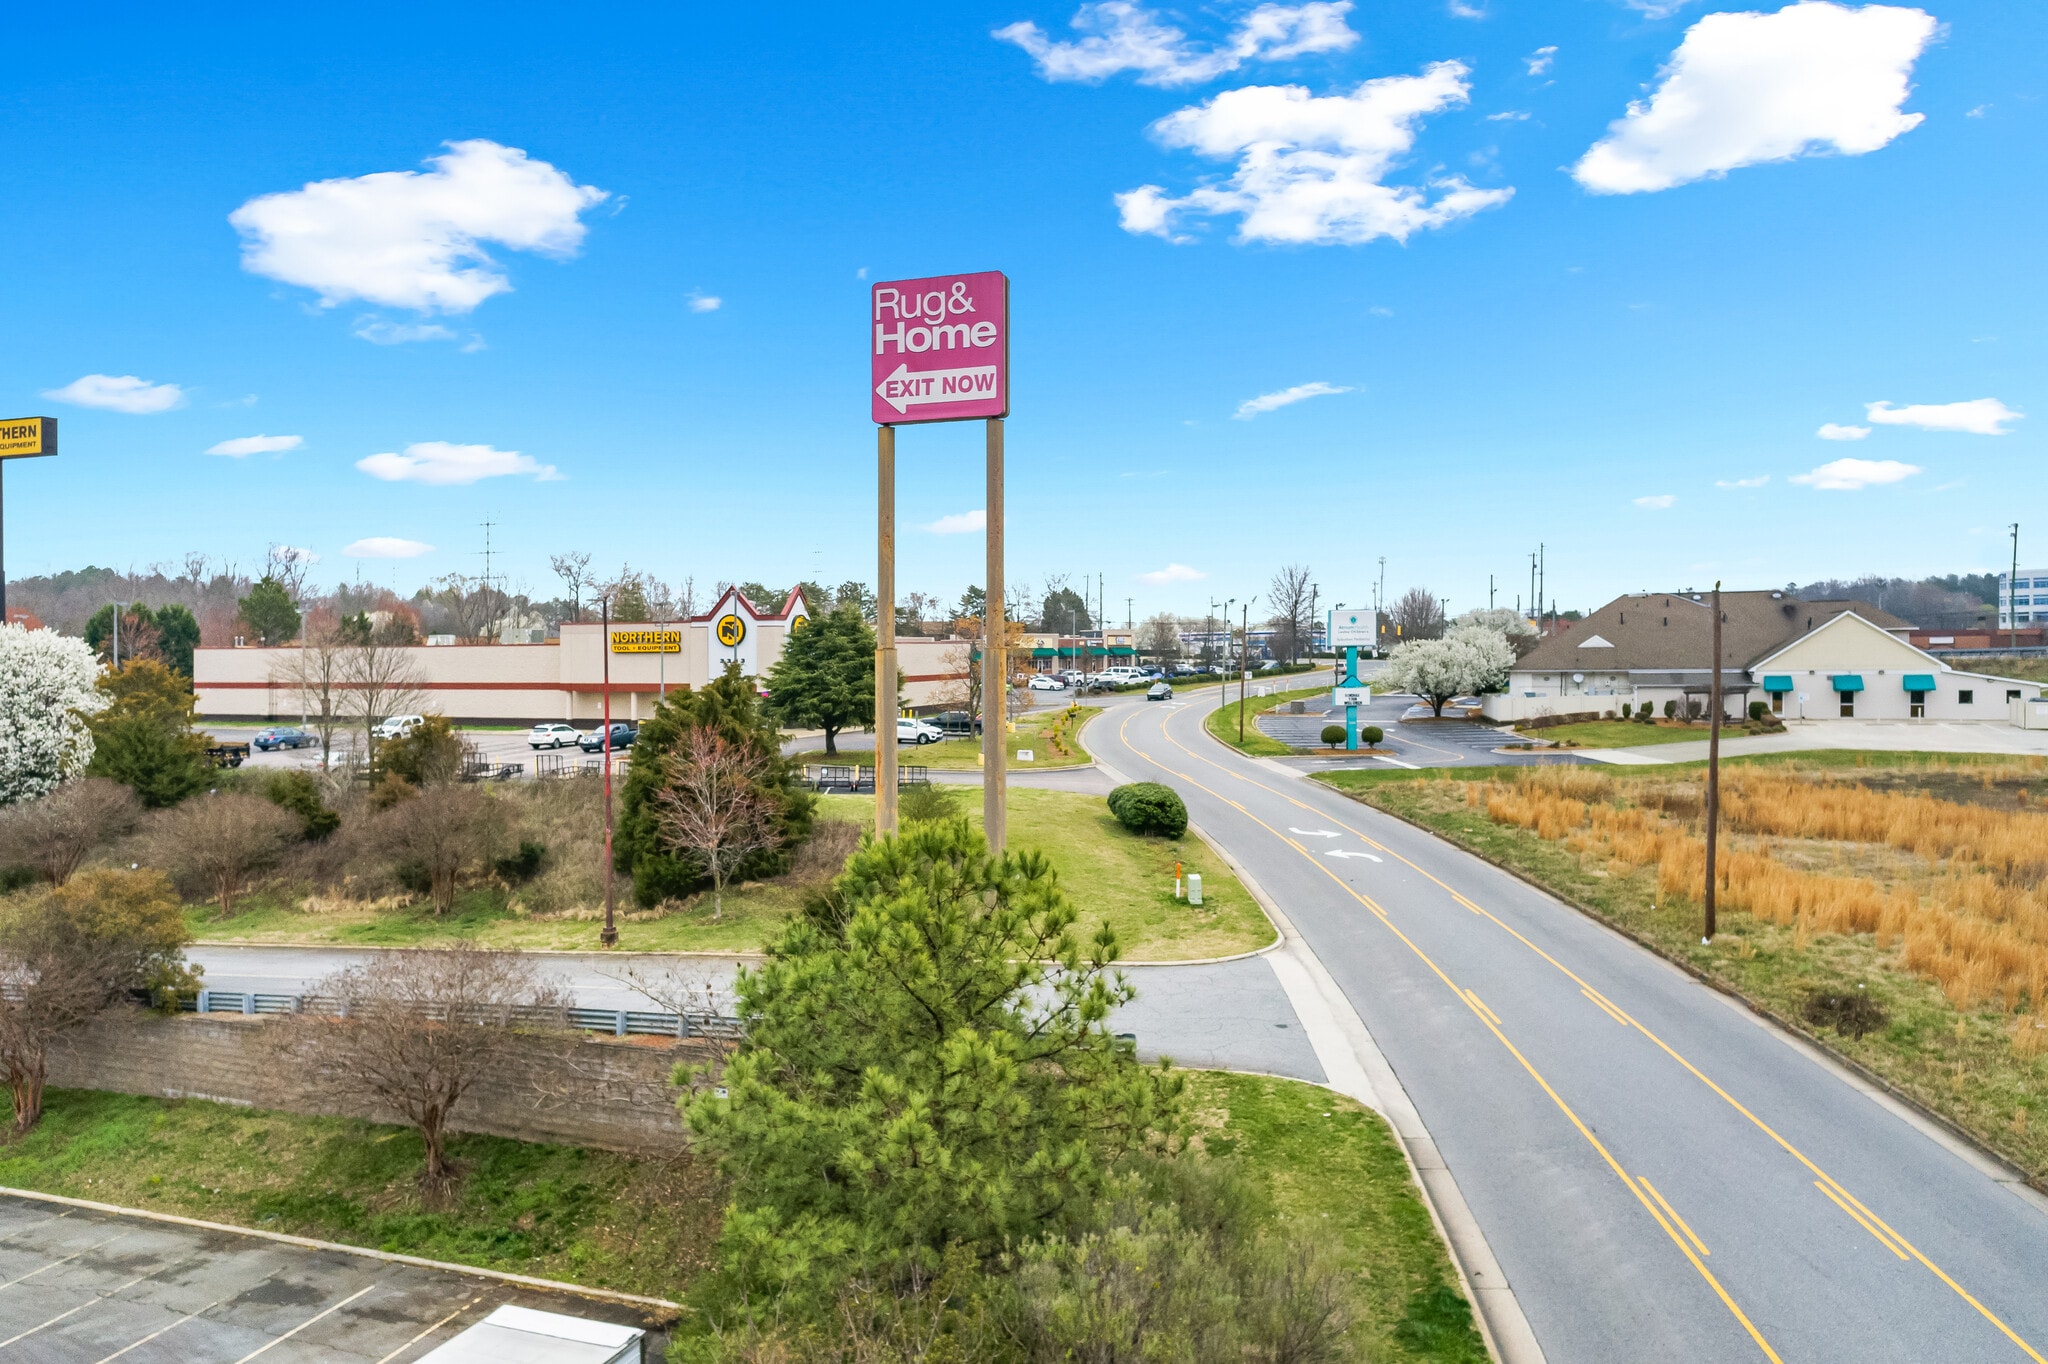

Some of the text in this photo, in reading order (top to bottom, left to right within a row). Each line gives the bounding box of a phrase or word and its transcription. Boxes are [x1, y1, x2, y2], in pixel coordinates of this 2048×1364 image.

[875, 281, 976, 325] Rug&
[875, 320, 997, 355] Home
[885, 373, 995, 398] EXIT NOW
[611, 631, 681, 644] NORTHERN
